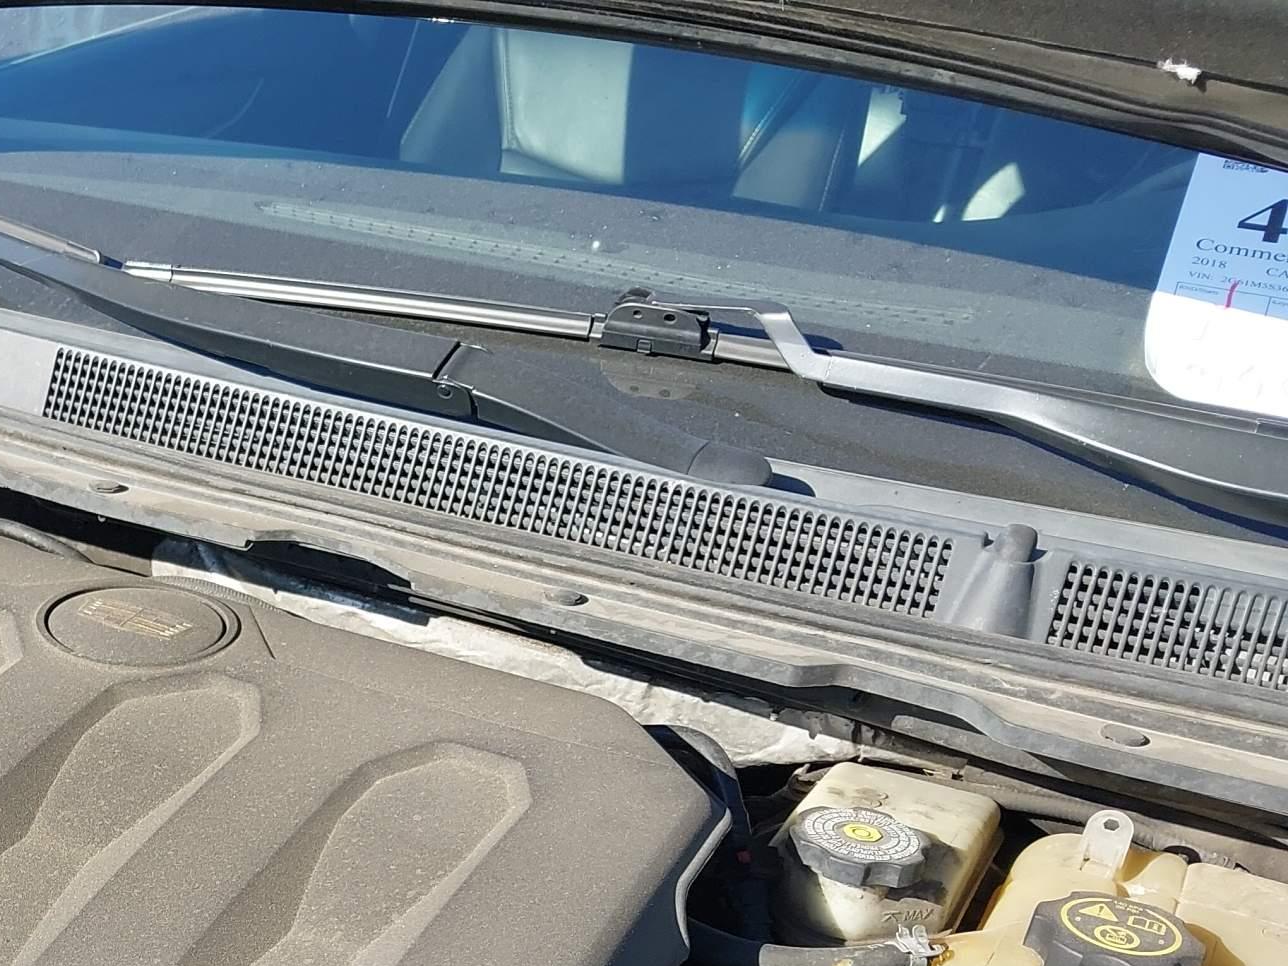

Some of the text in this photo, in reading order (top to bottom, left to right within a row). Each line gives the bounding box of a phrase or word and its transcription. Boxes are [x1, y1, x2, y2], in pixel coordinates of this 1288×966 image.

[1196, 238, 1288, 263] Comme
[1191, 256, 1228, 269] 2018
[1189, 271, 1214, 281] VIN:
[903, 908, 934, 921] MAX
